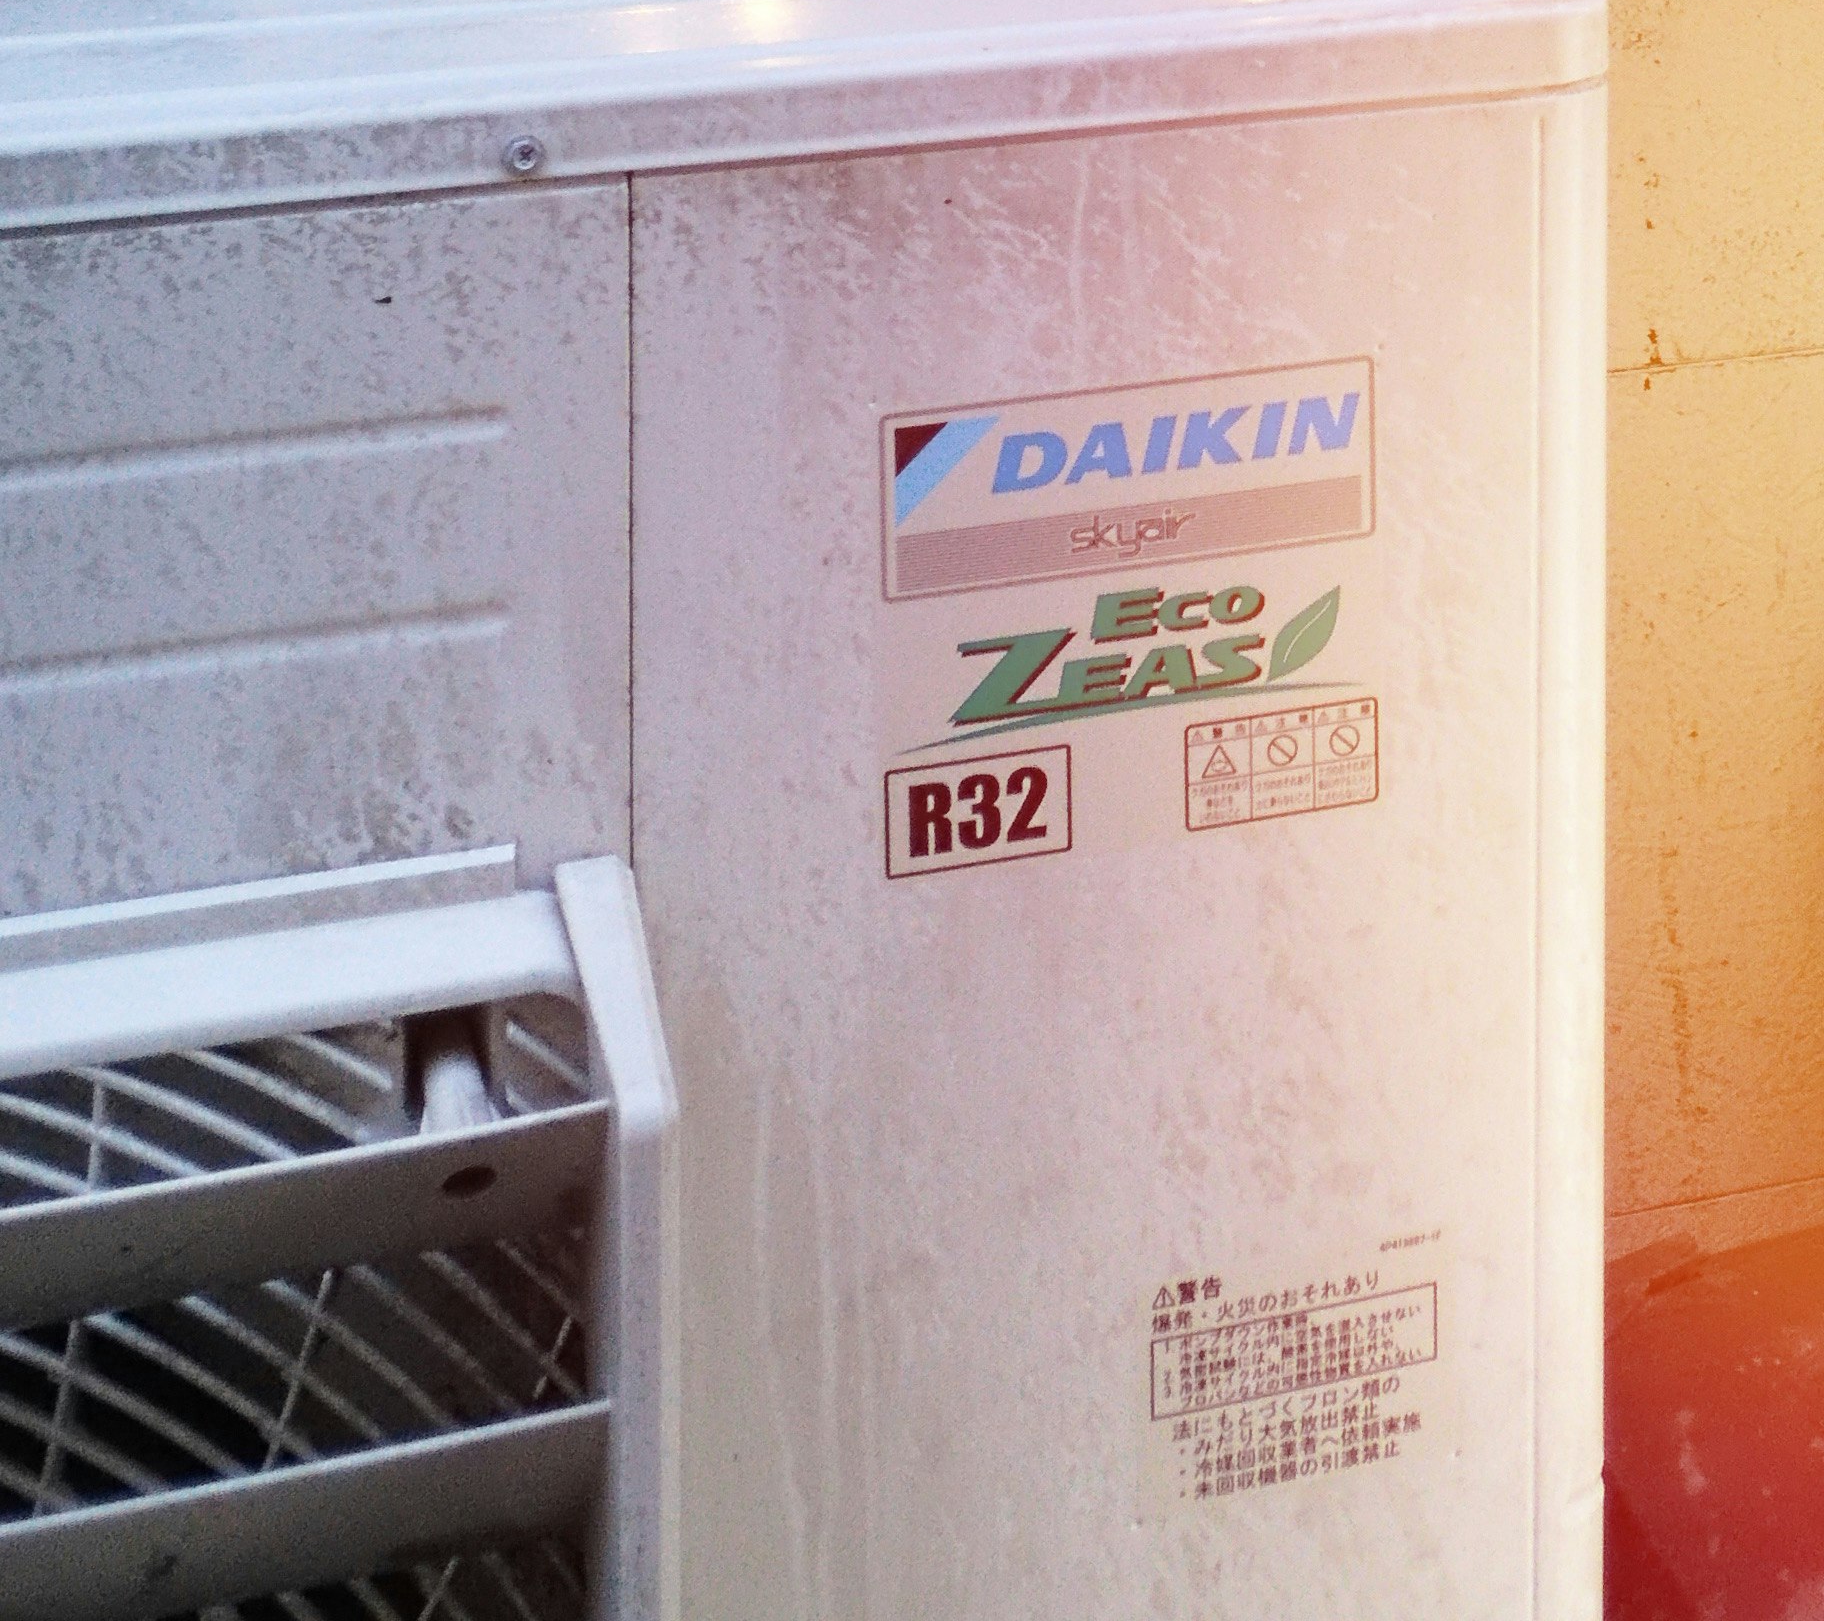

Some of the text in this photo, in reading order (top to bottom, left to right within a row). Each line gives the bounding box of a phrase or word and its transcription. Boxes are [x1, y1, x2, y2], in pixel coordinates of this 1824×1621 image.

[992, 392, 1360, 495] DAIKIN
[951, 628, 1266, 726] ZEAS
[909, 766, 1048, 858] R32
[1177, 1275, 1222, 1305] 警告
